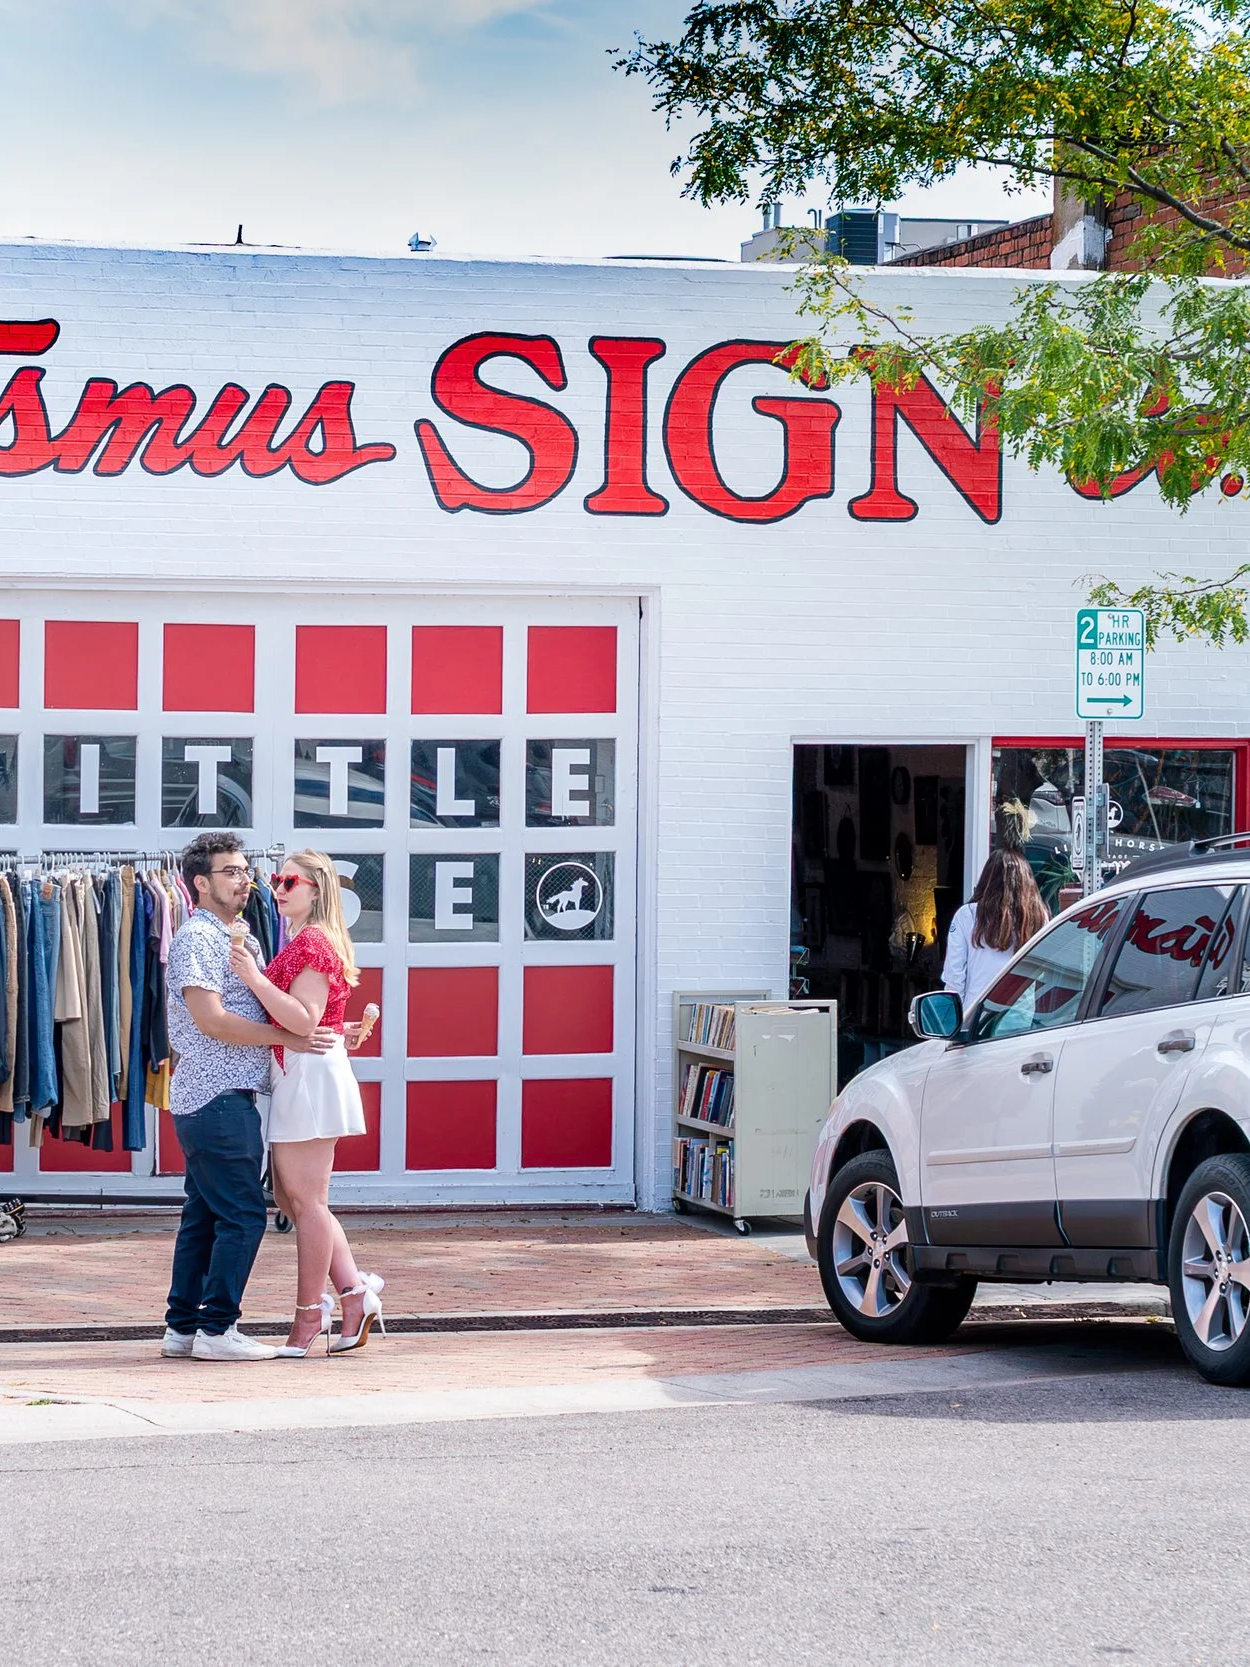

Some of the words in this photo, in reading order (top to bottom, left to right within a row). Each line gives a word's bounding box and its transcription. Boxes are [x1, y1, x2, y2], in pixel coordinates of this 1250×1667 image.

[414, 331, 1003, 525] SIGN
[1080, 616, 1095, 644] 2
[1112, 615, 1130, 628] HR
[1098, 632, 1141, 646] PARKING
[1090, 652, 1114, 665] 8:00
[1118, 652, 1133, 665] AM
[1081, 672, 1093, 686] TO
[1097, 672, 1122, 686] 6:00
[1126, 672, 1140, 686] PM
[1114, 838, 1166, 852] HORS
